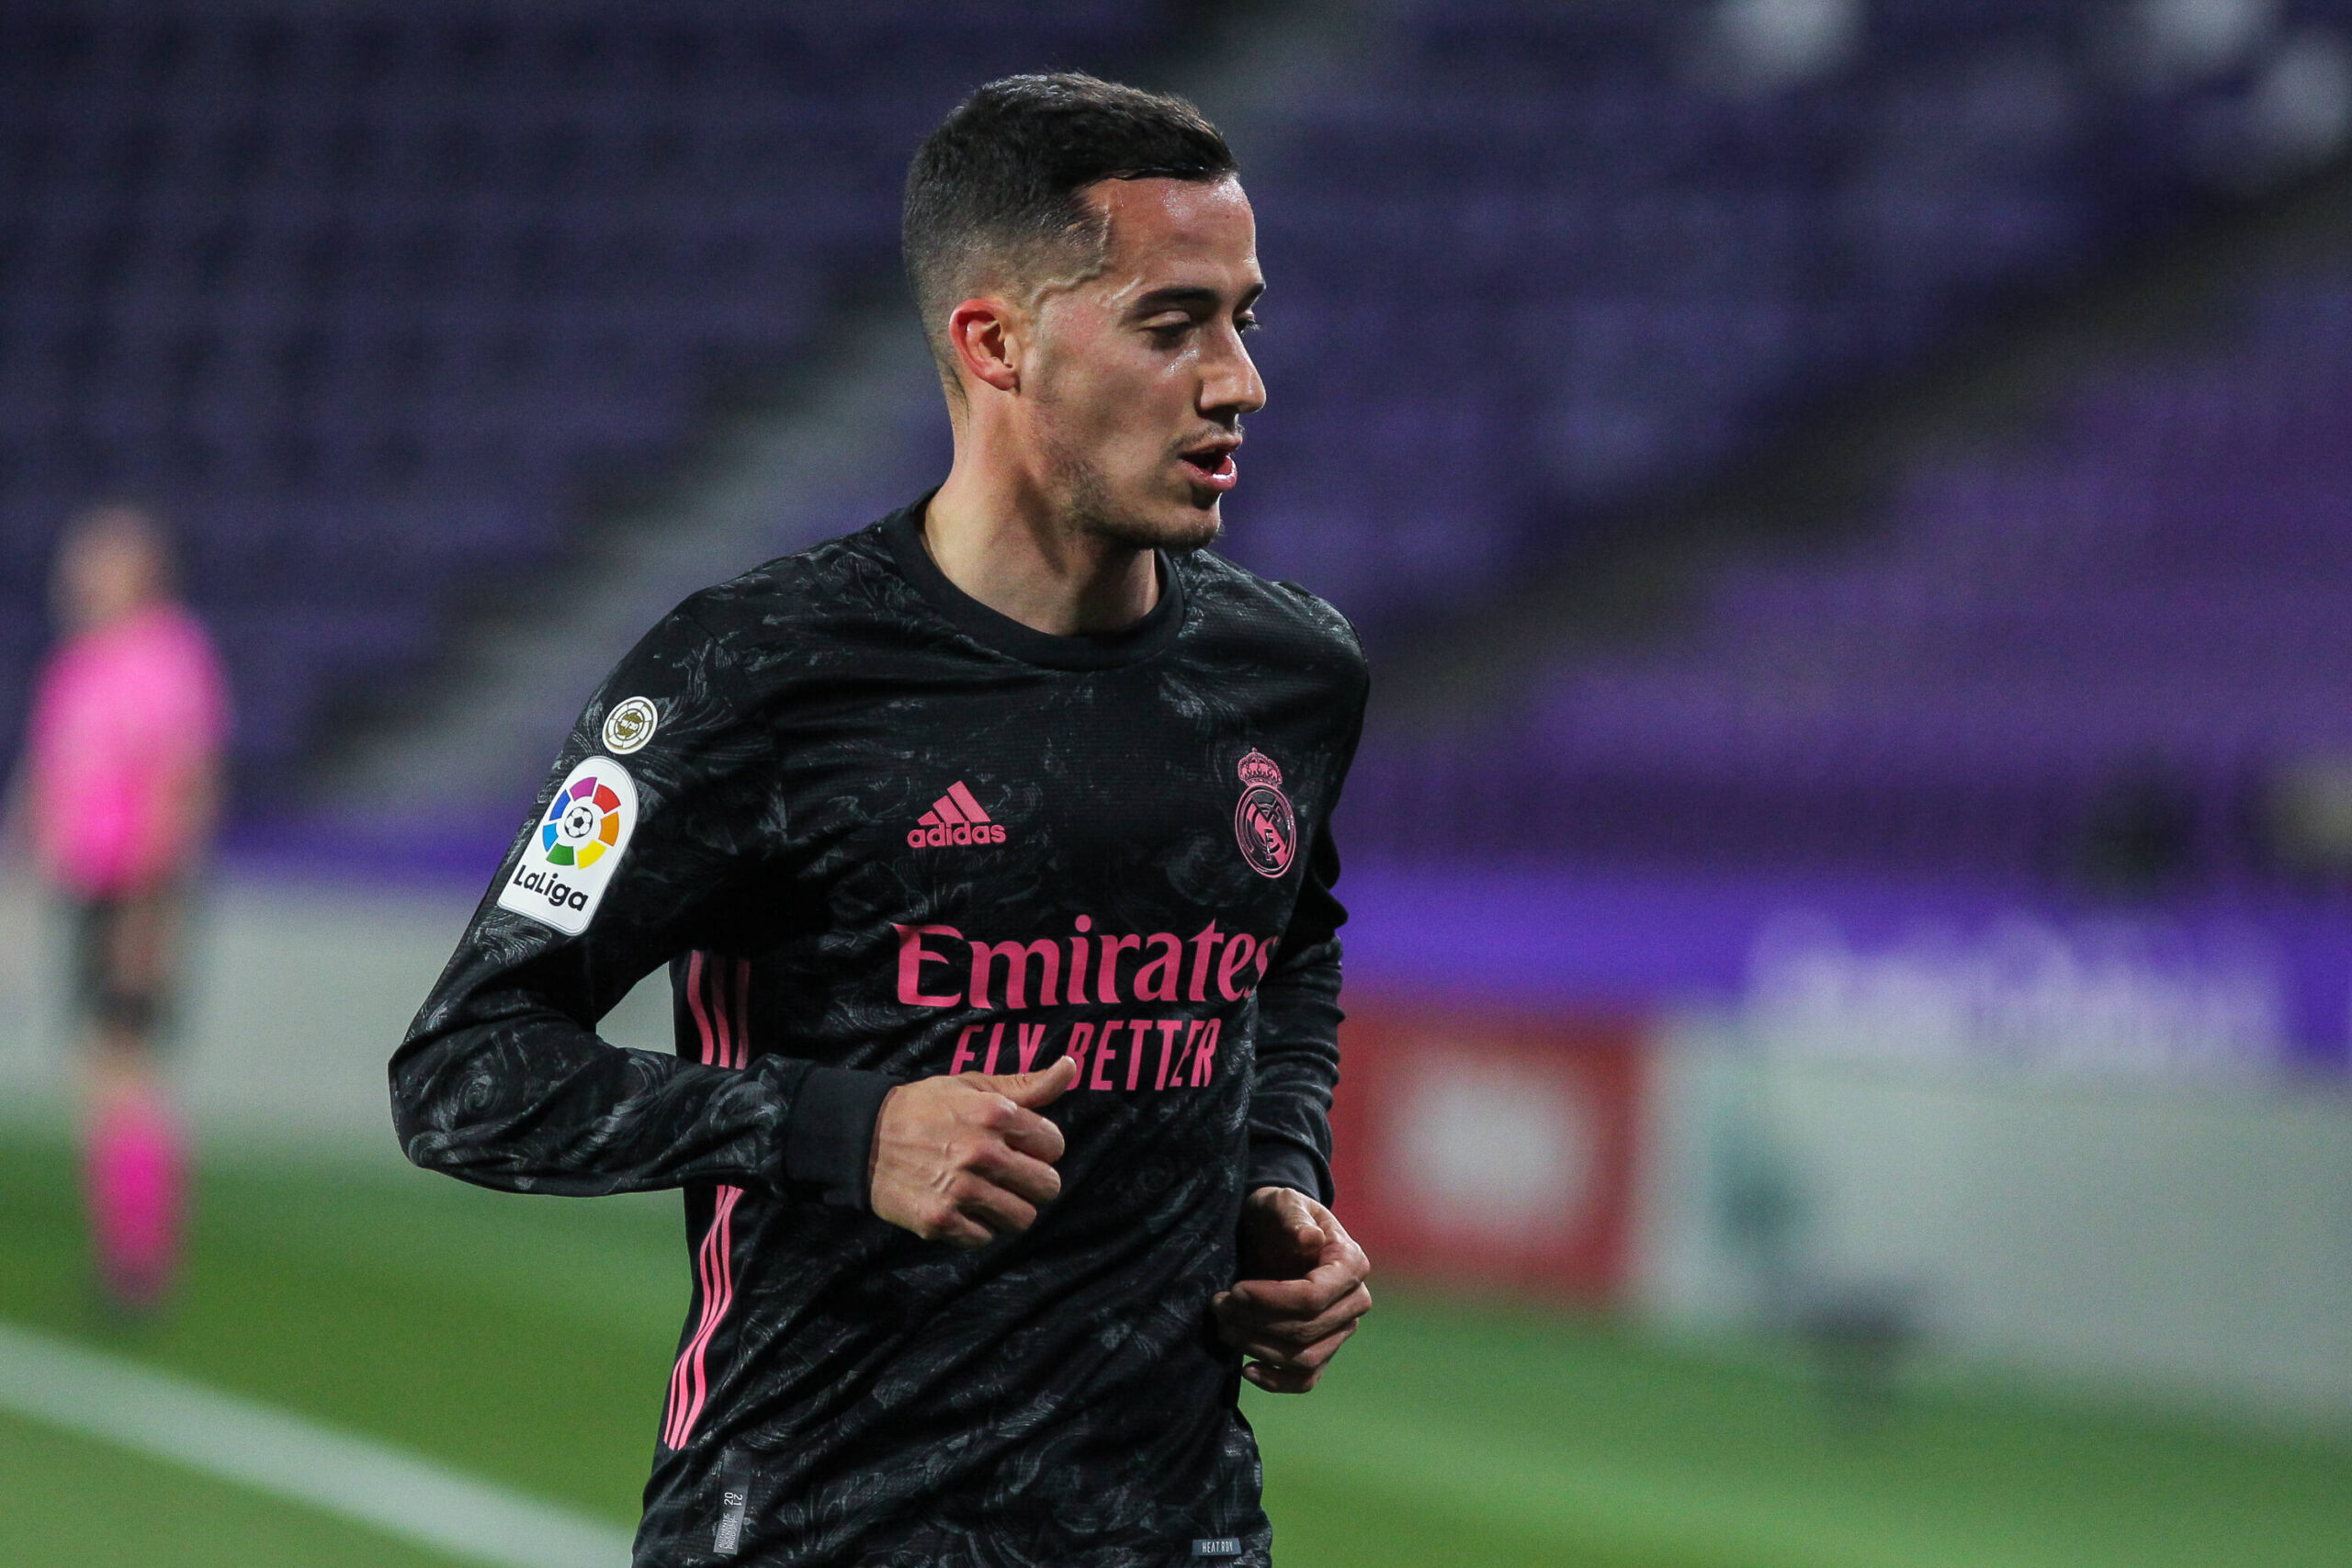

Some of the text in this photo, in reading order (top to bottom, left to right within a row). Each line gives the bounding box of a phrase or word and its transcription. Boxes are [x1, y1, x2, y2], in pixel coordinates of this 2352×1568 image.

[907, 821, 1007, 848] adidas
[512, 864, 589, 912] LaLiga
[892, 914, 1278, 1010] Emirates
[1066, 1018, 1221, 1090] BETTER
[724, 1492, 734, 1506] 20
